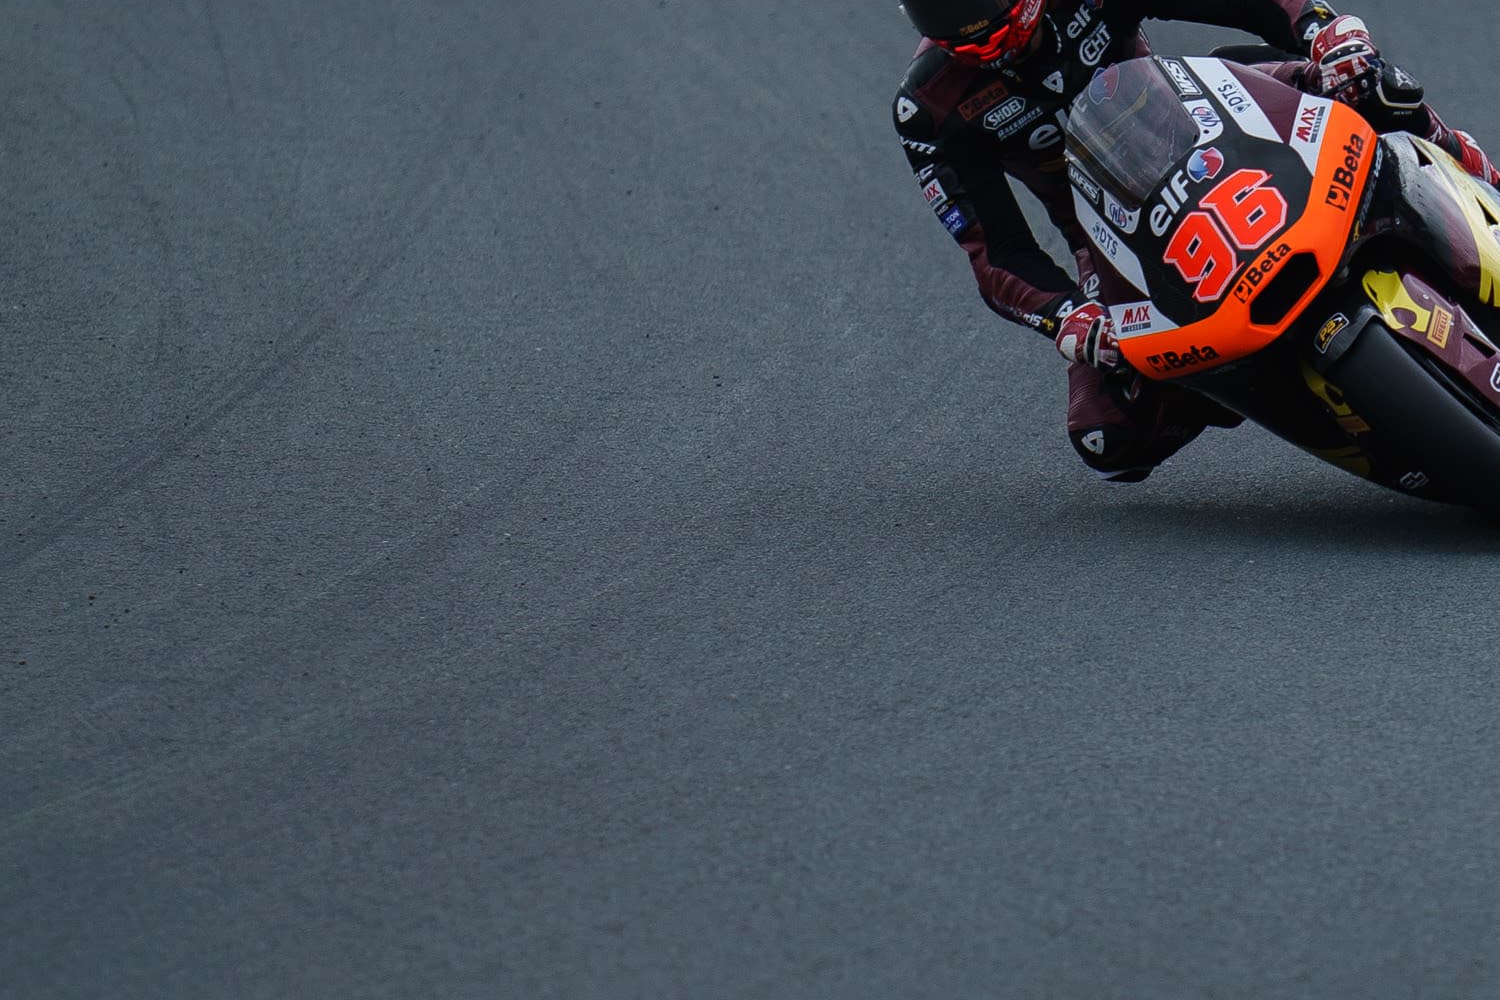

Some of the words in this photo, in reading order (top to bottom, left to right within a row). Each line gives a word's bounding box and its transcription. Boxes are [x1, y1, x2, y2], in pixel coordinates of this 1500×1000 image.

[1067, 3, 1091, 38] elf
[1217, 84, 1244, 107] DTS
[987, 100, 1021, 127] SHOEI
[1296, 106, 1318, 142] MAX
[1333, 133, 1364, 191] Beta
[1150, 169, 1190, 237] elf
[1099, 226, 1118, 256] DTS
[1163, 168, 1288, 303] 96
[1245, 243, 1292, 288] Beta
[1121, 305, 1151, 325] MAX
[1162, 345, 1221, 370] Beta
